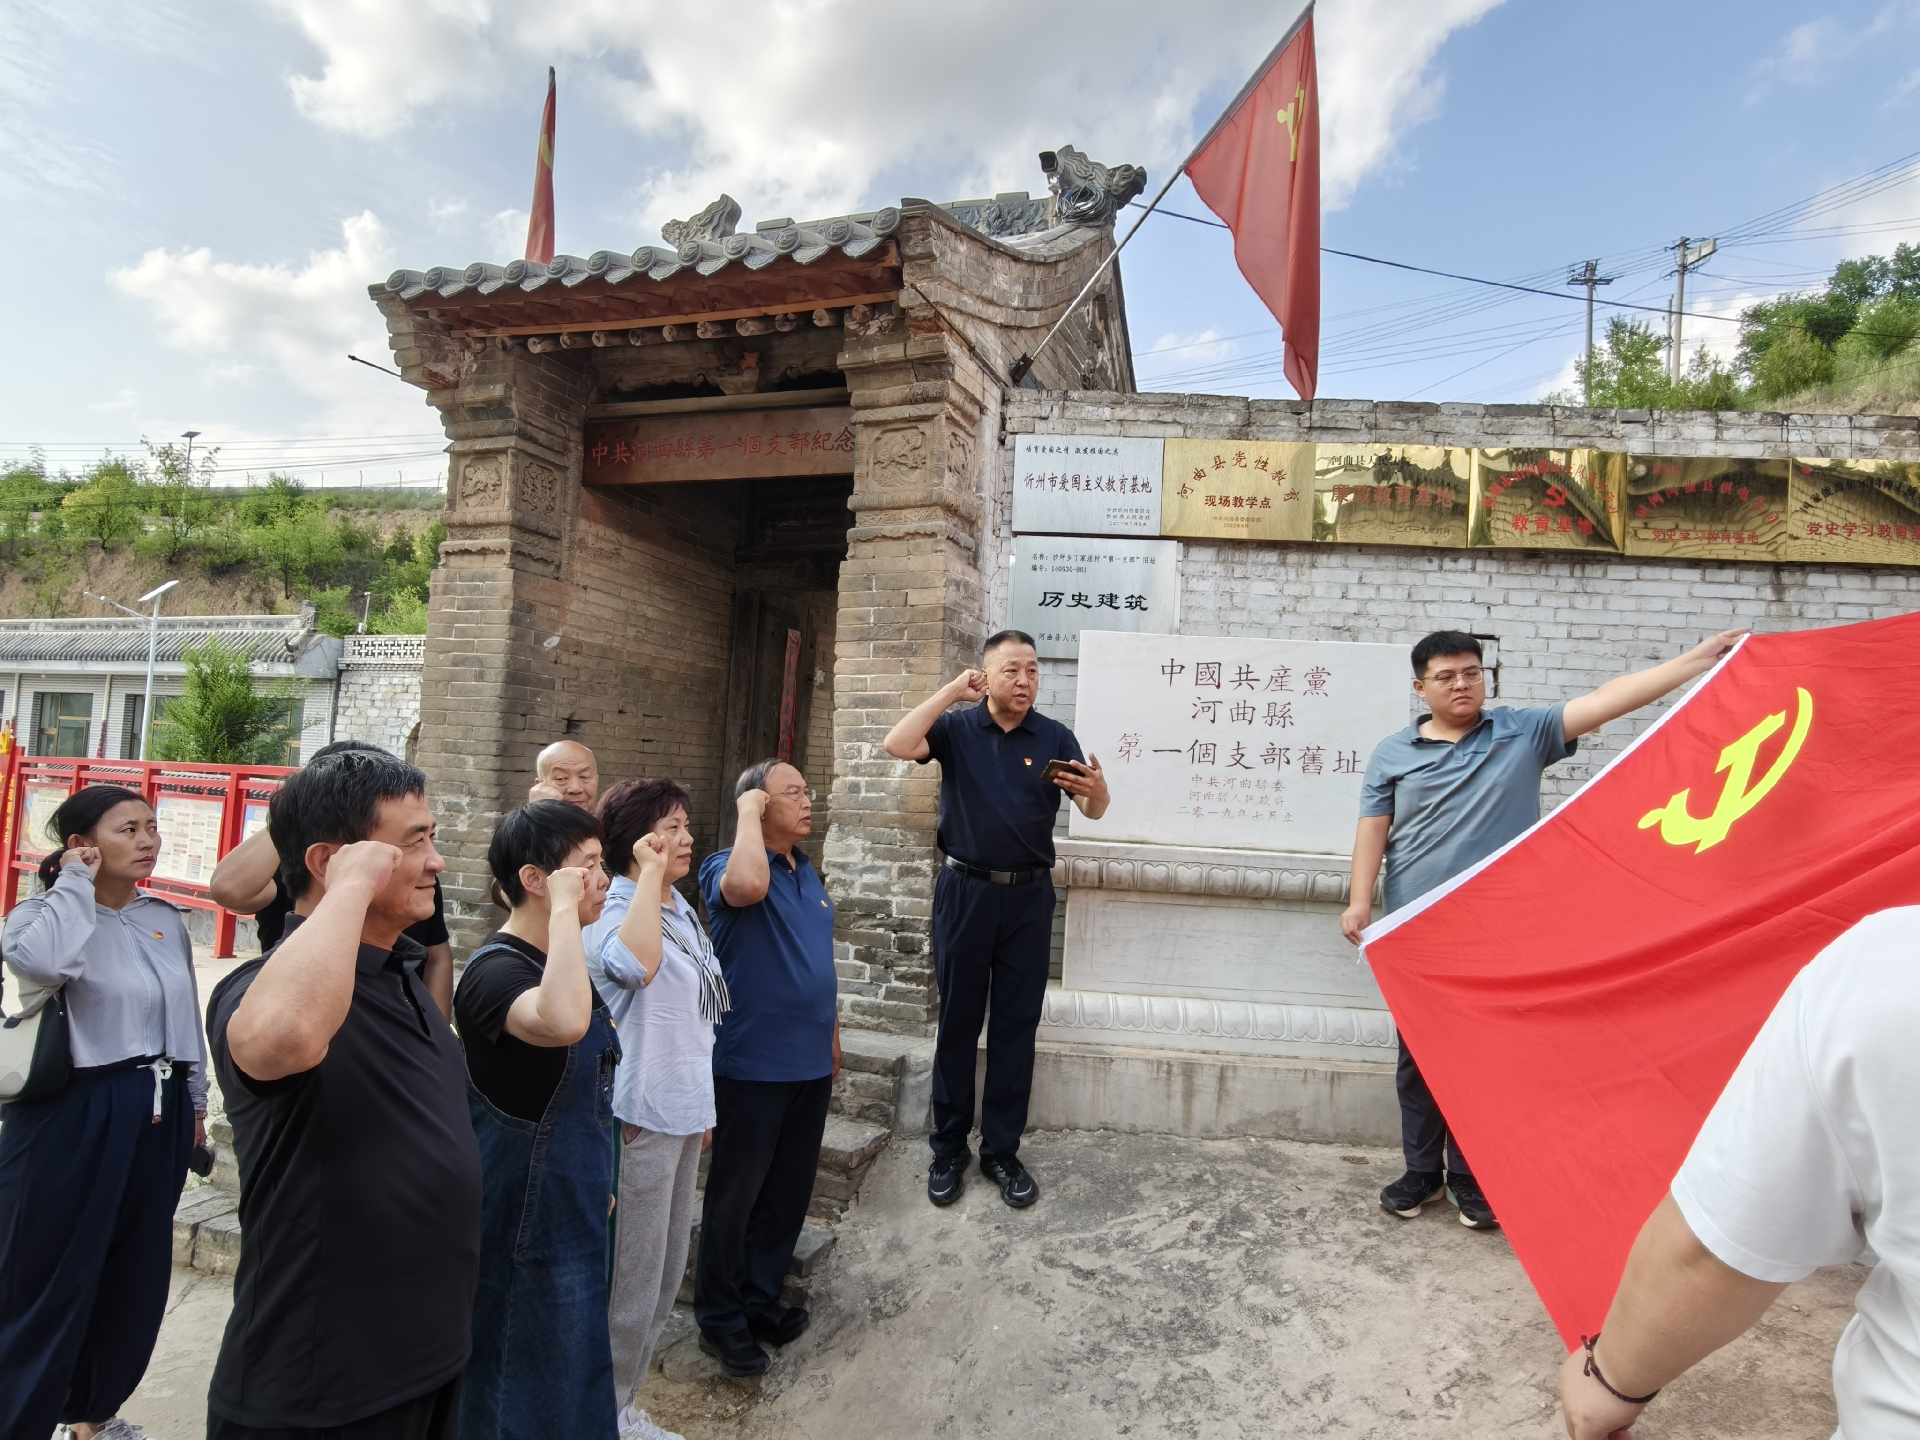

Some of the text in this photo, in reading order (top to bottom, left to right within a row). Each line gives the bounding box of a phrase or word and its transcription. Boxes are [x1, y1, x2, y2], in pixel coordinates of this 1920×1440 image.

[1024, 472, 1152, 494] 忻州市爱国主义教育基地
[1176, 450, 1300, 502] 河曲县党性教育
[1204, 495, 1272, 509] 现场教学点
[1331, 483, 1454, 508] 廉政教育基地
[1512, 515, 1594, 535] 教育基地
[1651, 529, 1759, 545] 党史学习教育基地
[1038, 591, 1149, 612] 历史建筑
[1038, 633, 1080, 642] 河曲县人民
[1191, 696, 1295, 729] 河曲縣
[1117, 732, 1366, 776] 第一個支部舊址
[1191, 773, 1286, 792] 中共河曲縣委
[1189, 790, 1286, 808] 河曲縣人民政府
[1177, 806, 1294, 823] 二零一九年七月立
